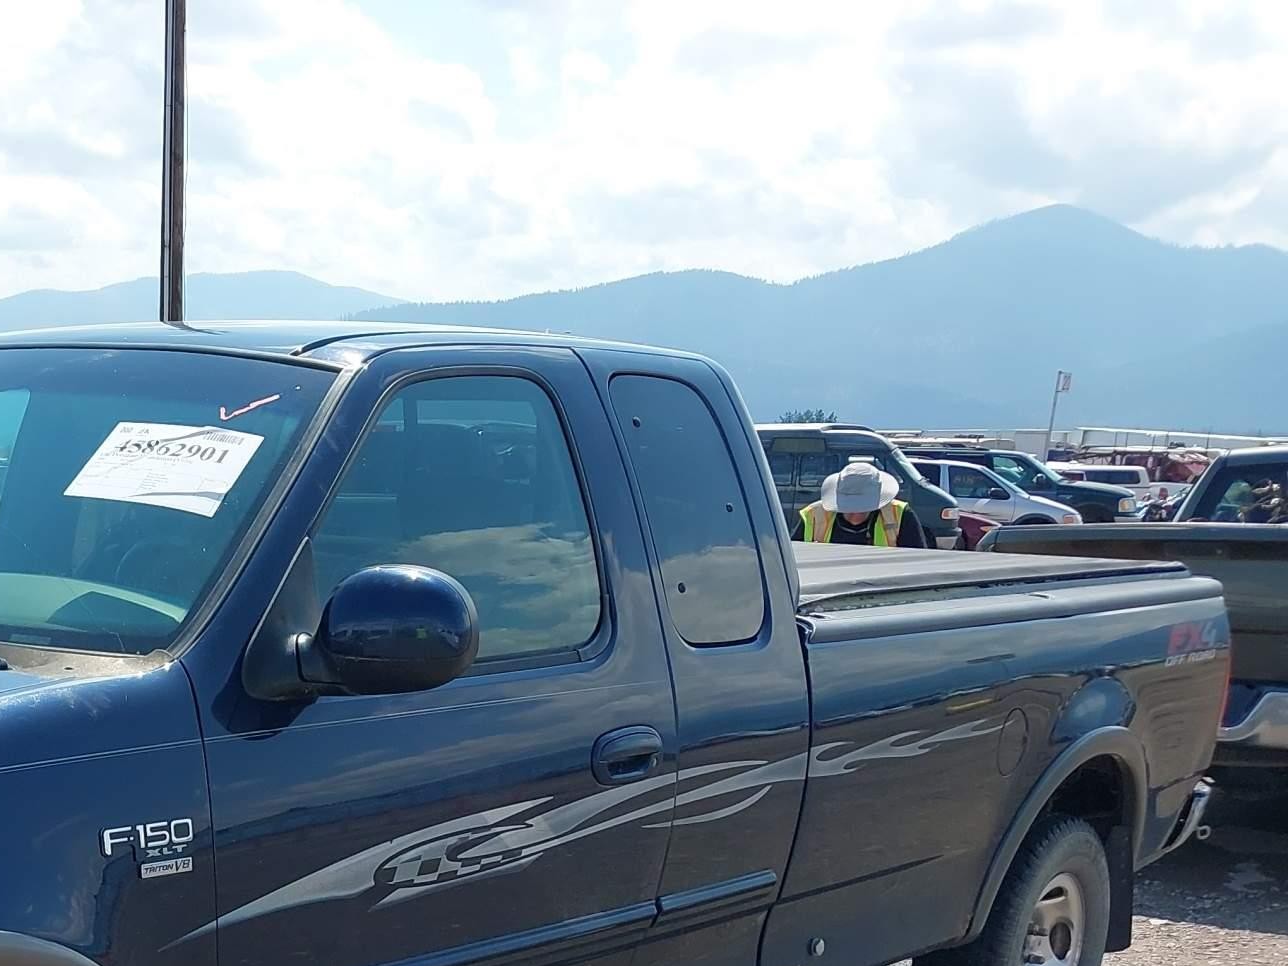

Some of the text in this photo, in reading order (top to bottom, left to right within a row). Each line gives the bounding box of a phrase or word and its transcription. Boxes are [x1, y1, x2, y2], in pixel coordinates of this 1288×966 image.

[114, 439, 230, 464] 45862901
[1167, 621, 1217, 656] FX4
[146, 844, 188, 858] XLT
[144, 859, 190, 875] TRITON V8
